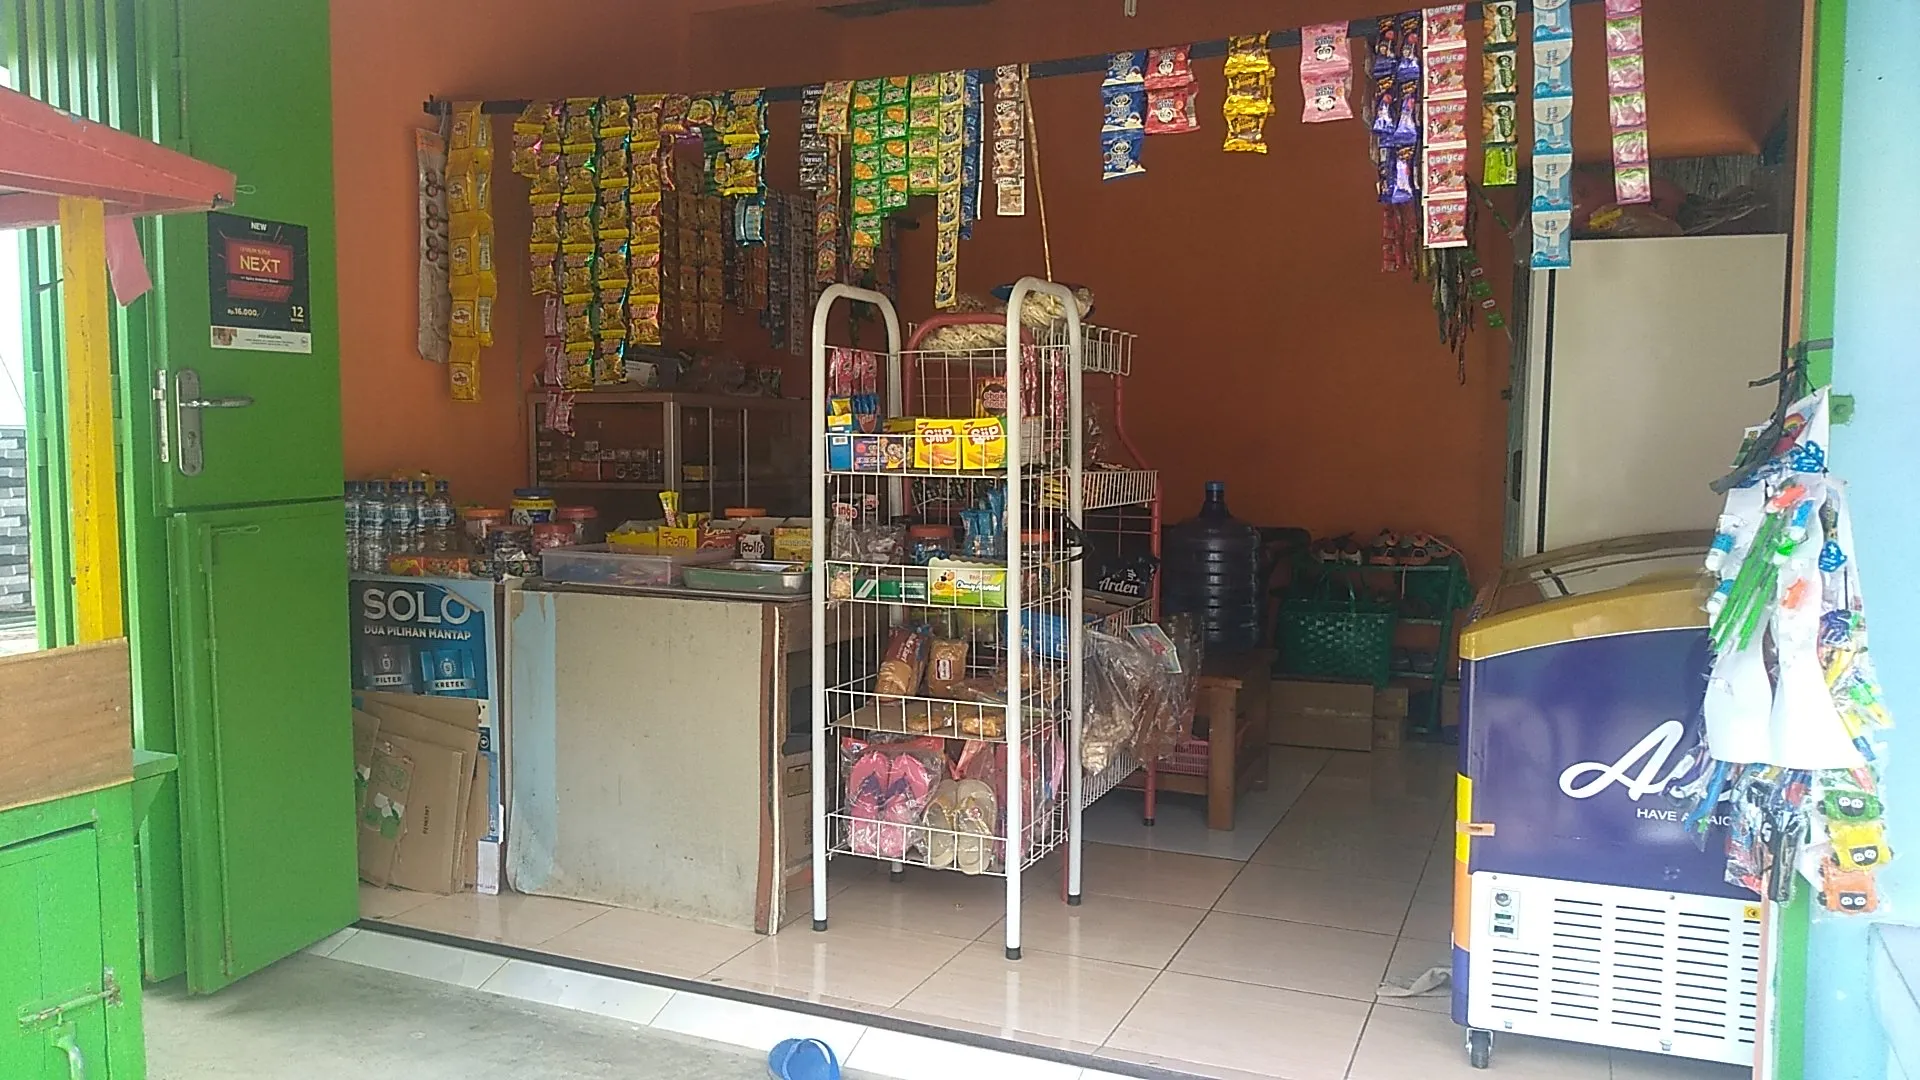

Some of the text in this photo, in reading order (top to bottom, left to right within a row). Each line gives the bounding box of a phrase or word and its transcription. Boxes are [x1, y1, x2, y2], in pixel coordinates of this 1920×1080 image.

[251, 222, 267, 231] NEW
[239, 255, 281, 274] NEXT
[292, 306, 304, 317] 12
[742, 541, 765, 555] Rolls
[1099, 577, 1139, 595] Arden
[363, 589, 471, 625] SOLO
[364, 625, 471, 641] DUA PILIHAN MANTAP
[375, 676, 402, 684] FILTER
[435, 681, 465, 689] KRETEK
[1637, 808, 1677, 821] HAVE
